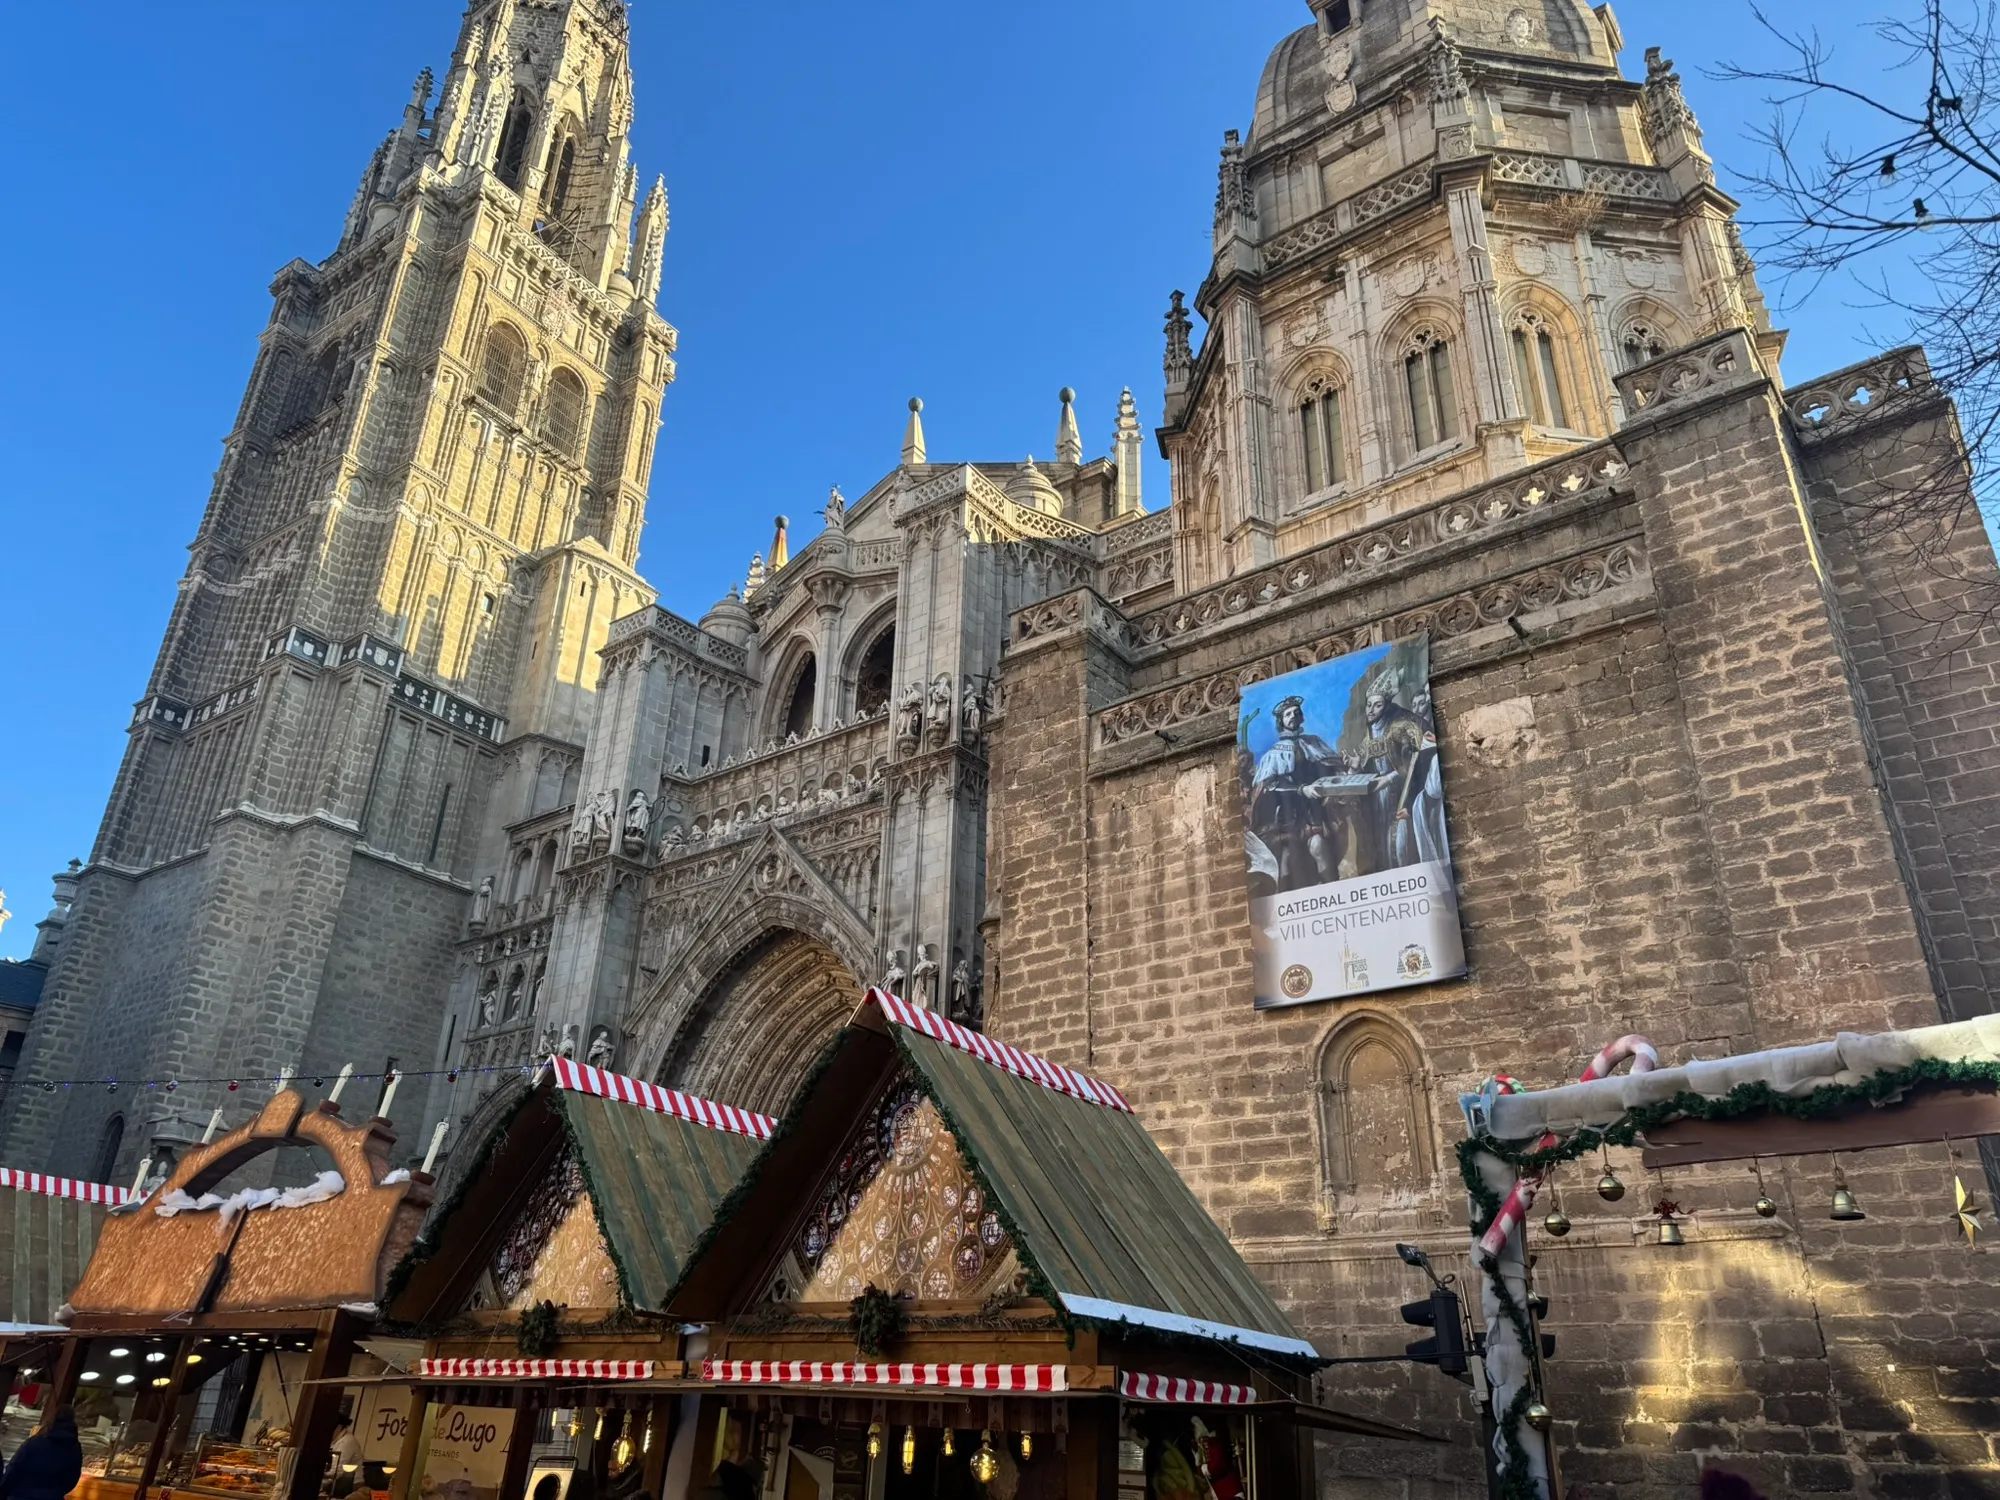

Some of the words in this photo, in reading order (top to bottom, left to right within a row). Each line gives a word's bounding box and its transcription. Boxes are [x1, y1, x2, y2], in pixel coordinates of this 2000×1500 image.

[1277, 893, 1346, 917] CATEDRAL
[1350, 888, 1368, 902] DE
[1371, 876, 1427, 898] TOLEDO
[1279, 922, 1306, 941] VIII
[1311, 898, 1430, 936] CENTENARIO
[445, 1410, 496, 1452] Lugo
